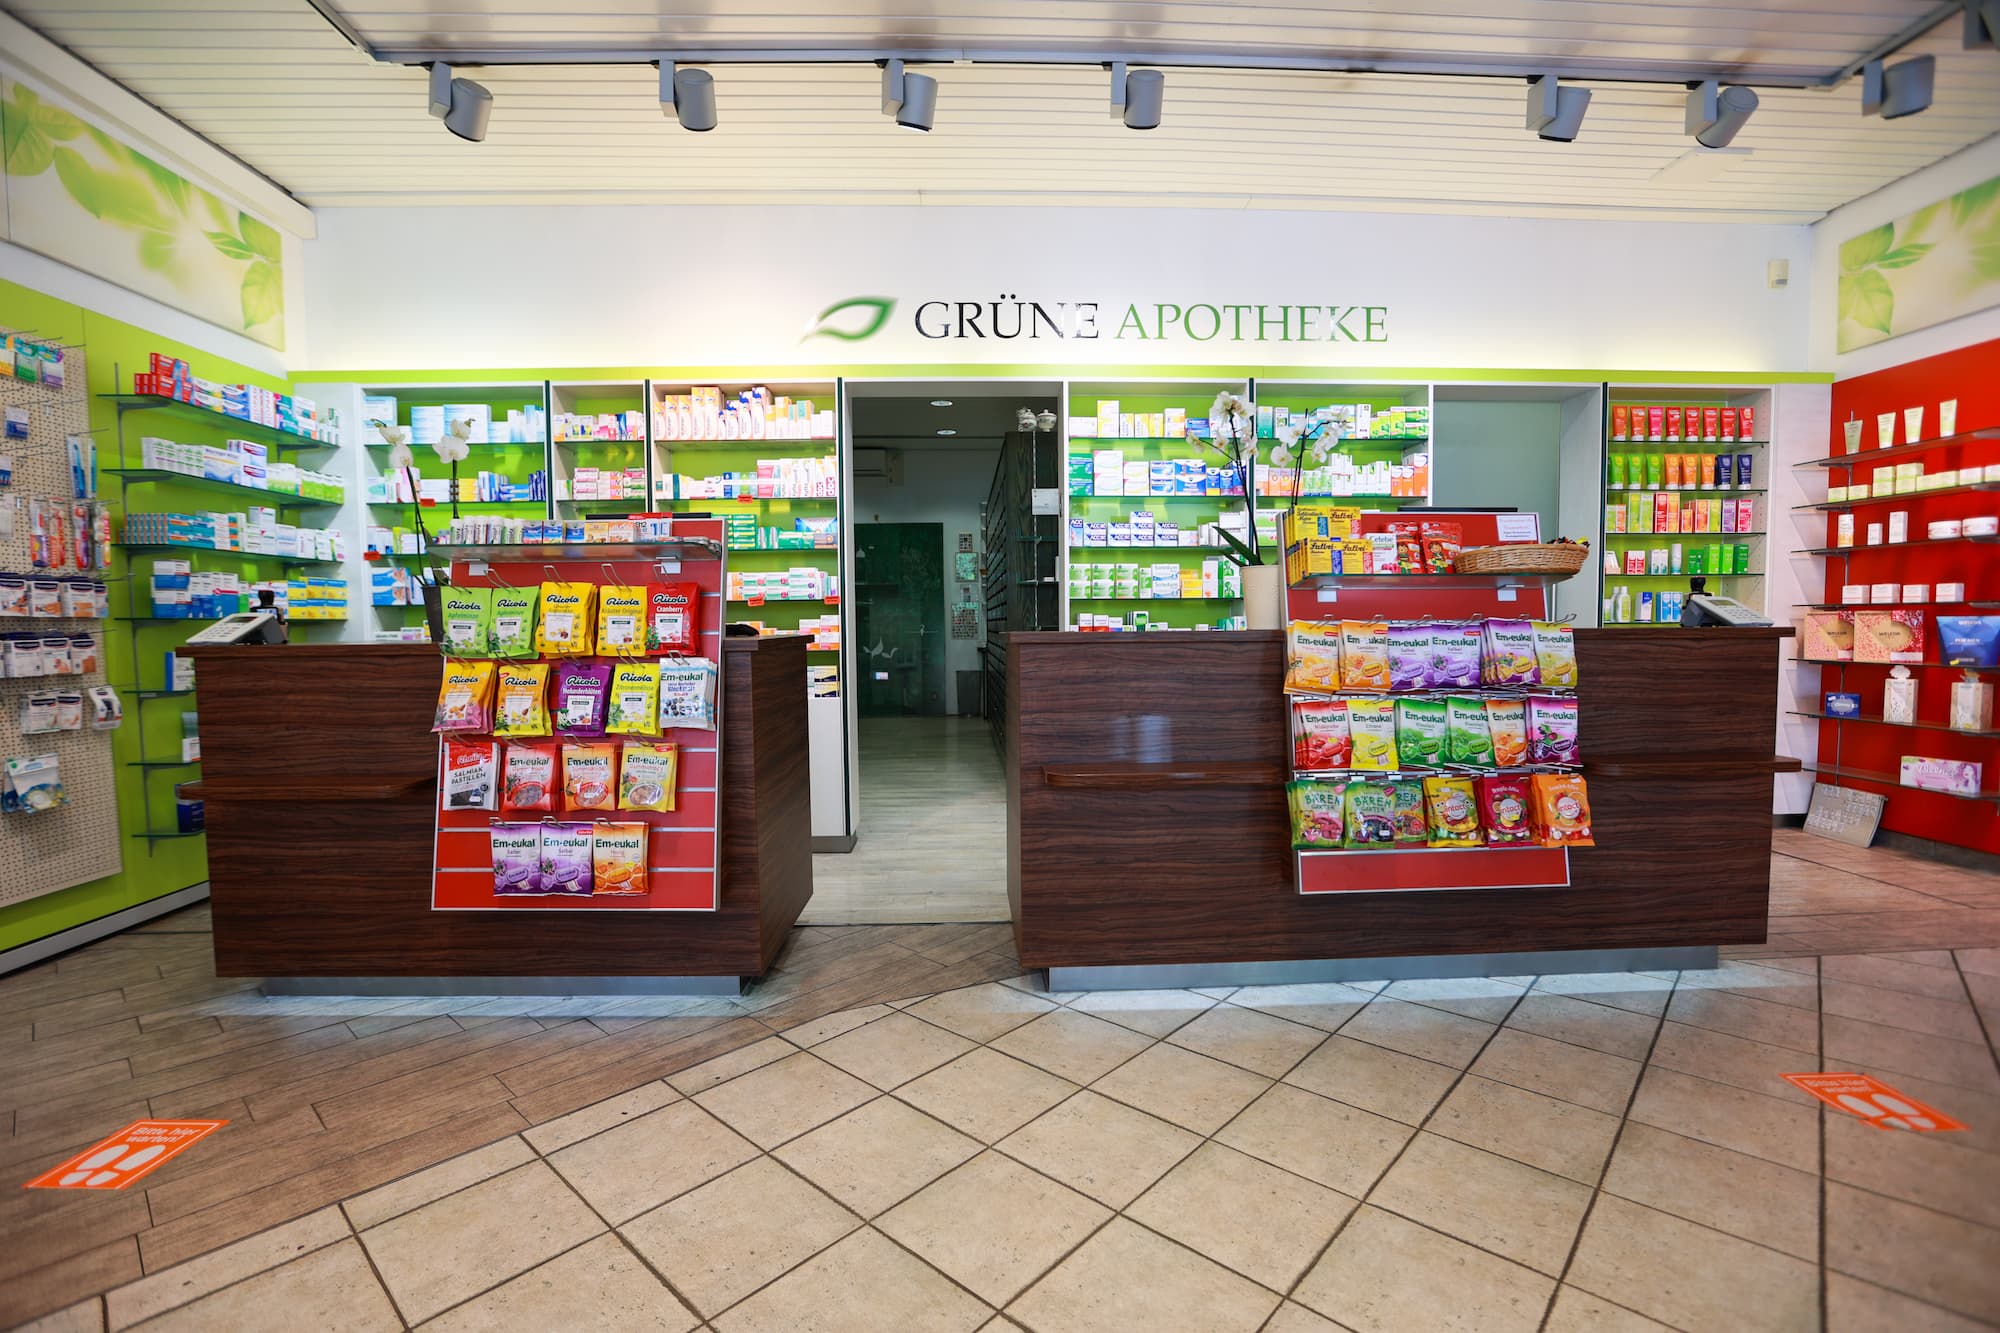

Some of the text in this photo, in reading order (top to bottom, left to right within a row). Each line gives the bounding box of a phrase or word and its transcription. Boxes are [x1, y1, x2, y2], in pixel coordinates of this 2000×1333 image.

[914, 293, 1388, 343] GRÜNE APOTHEKE
[497, 599, 528, 608] Ricola
[546, 595, 579, 603] Ricola
[606, 598, 640, 606] Ricola
[653, 594, 688, 604] Ricola
[447, 601, 481, 610] Ricola
[1297, 635, 1336, 647] Em-eukal
[1387, 638, 1429, 647] Em-eukal
[1432, 637, 1477, 646] Em-eukal
[449, 676, 478, 684] Ricola
[620, 673, 653, 682] Ricola
[661, 672, 703, 681] Em-eukal
[505, 677, 537, 686] Ricola
[567, 677, 600, 686] Ricola
[1305, 713, 1346, 723] Em-eukal
[1352, 713, 1392, 722] Em-eukal
[1405, 711, 1445, 723] Em-eukal
[1454, 710, 1488, 721] Em-euka
[1537, 709, 1577, 720] Em-eukal
[510, 756, 549, 766] Em-eukal
[493, 839, 535, 848] Em-eukal
[543, 838, 588, 847] Em-eukal
[595, 839, 639, 848] Em-eukal
